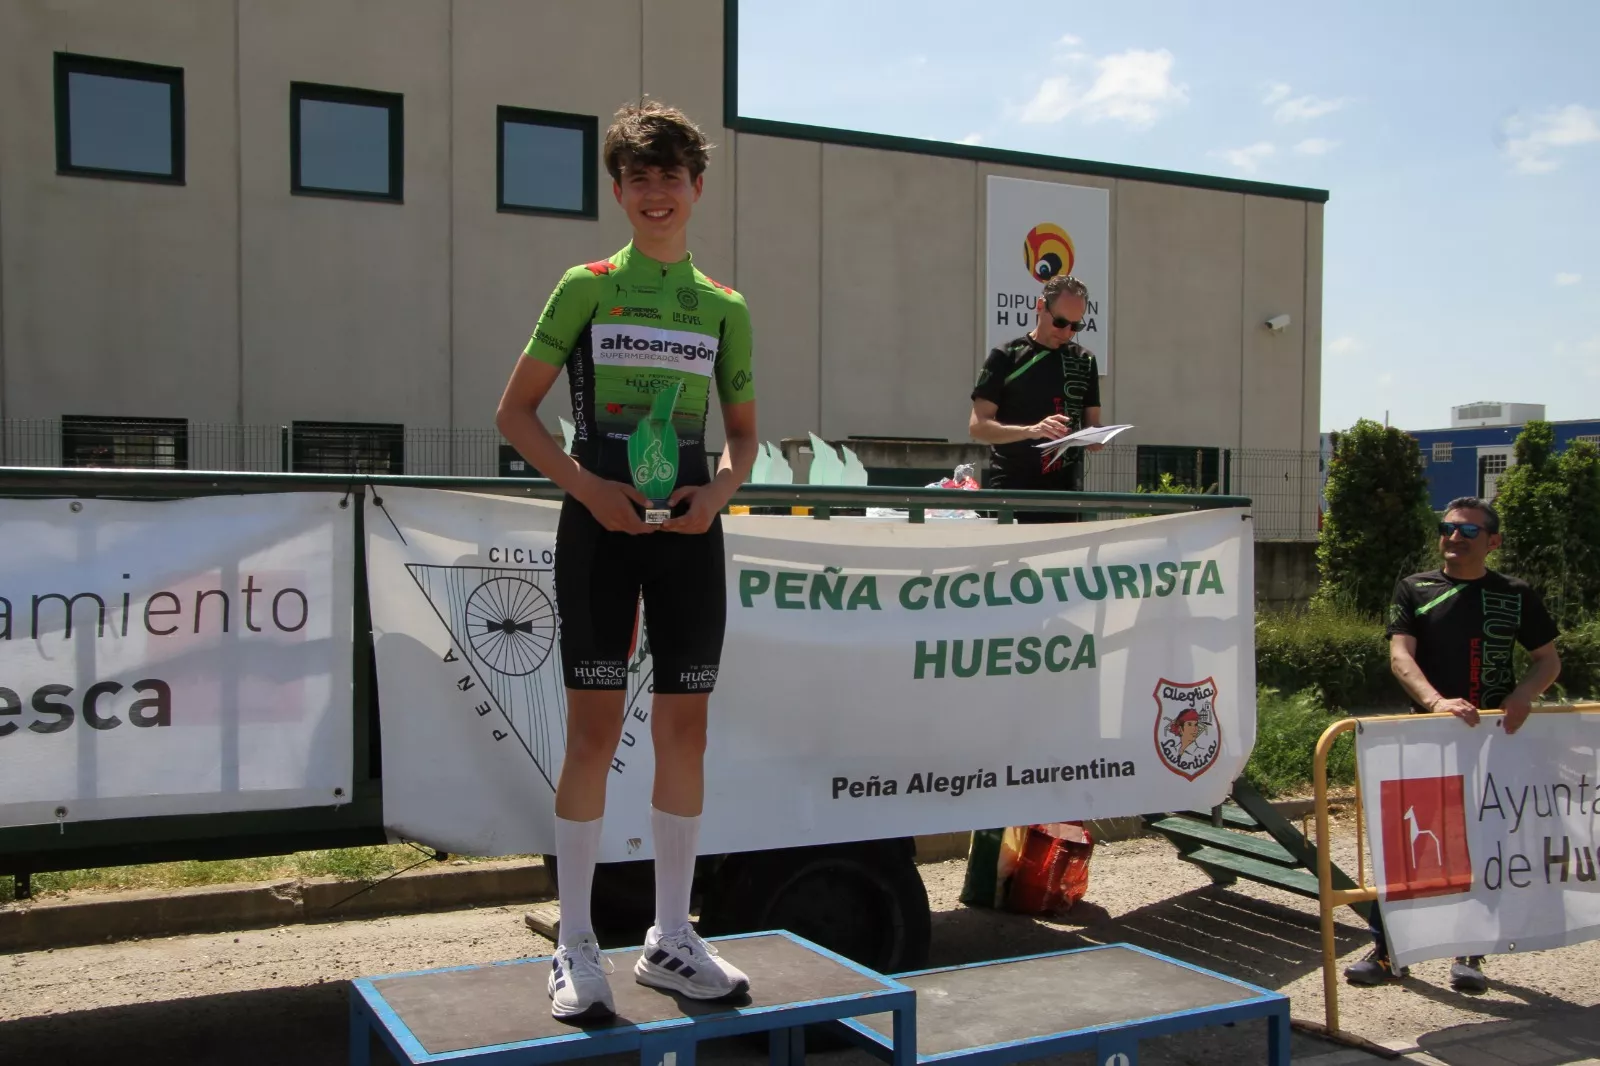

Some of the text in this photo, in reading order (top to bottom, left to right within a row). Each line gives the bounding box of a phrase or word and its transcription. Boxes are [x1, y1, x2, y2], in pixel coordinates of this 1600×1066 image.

[997, 293, 1098, 315] DIPUN
[997, 311, 1098, 332] HUA
[600, 351, 680, 363] SUPERMERCADOS
[739, 559, 1224, 610] PEÑA CICLOTURISTA
[913, 634, 1097, 680] HUESCA
[1482, 588, 1522, 710] HUESC
[832, 775, 898, 799] Peña
[1006, 758, 1136, 787] Laurentina
[1484, 835, 1600, 891] de Hu
